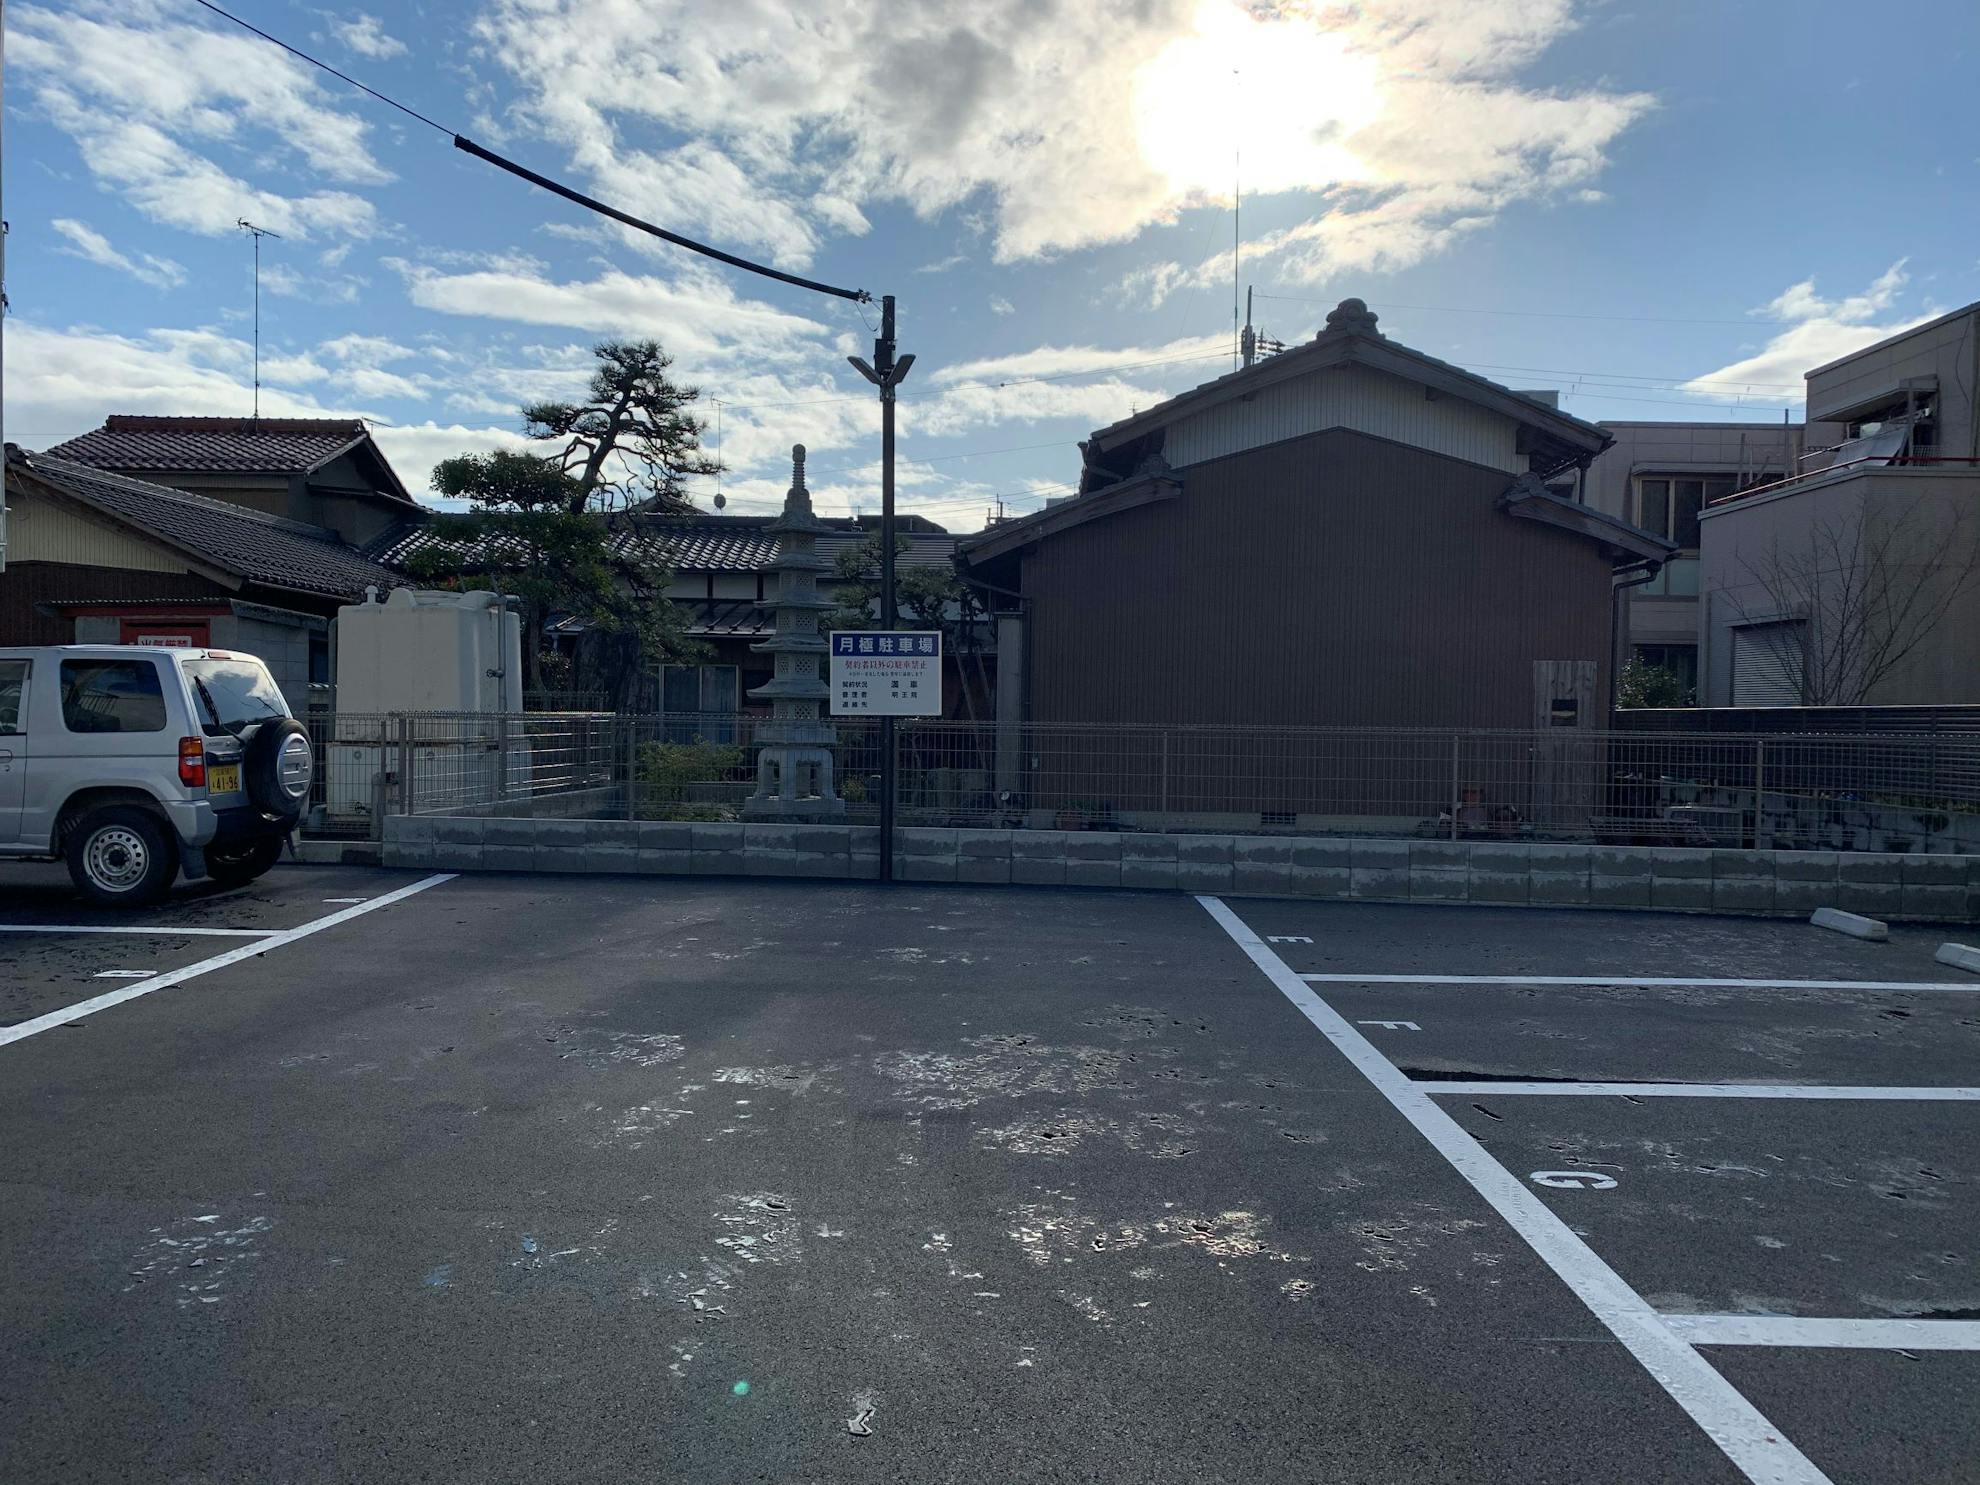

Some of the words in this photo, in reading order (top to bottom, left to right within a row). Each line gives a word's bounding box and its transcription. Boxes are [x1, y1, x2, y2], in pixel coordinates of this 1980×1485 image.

[839, 637, 933, 652] 月極駐車場
[845, 660, 928, 670] 契約者以外の駐車禁止
[1266, 935, 1314, 944] E
[1357, 1020, 1422, 1031] F
[1529, 1169, 1619, 1190] G
